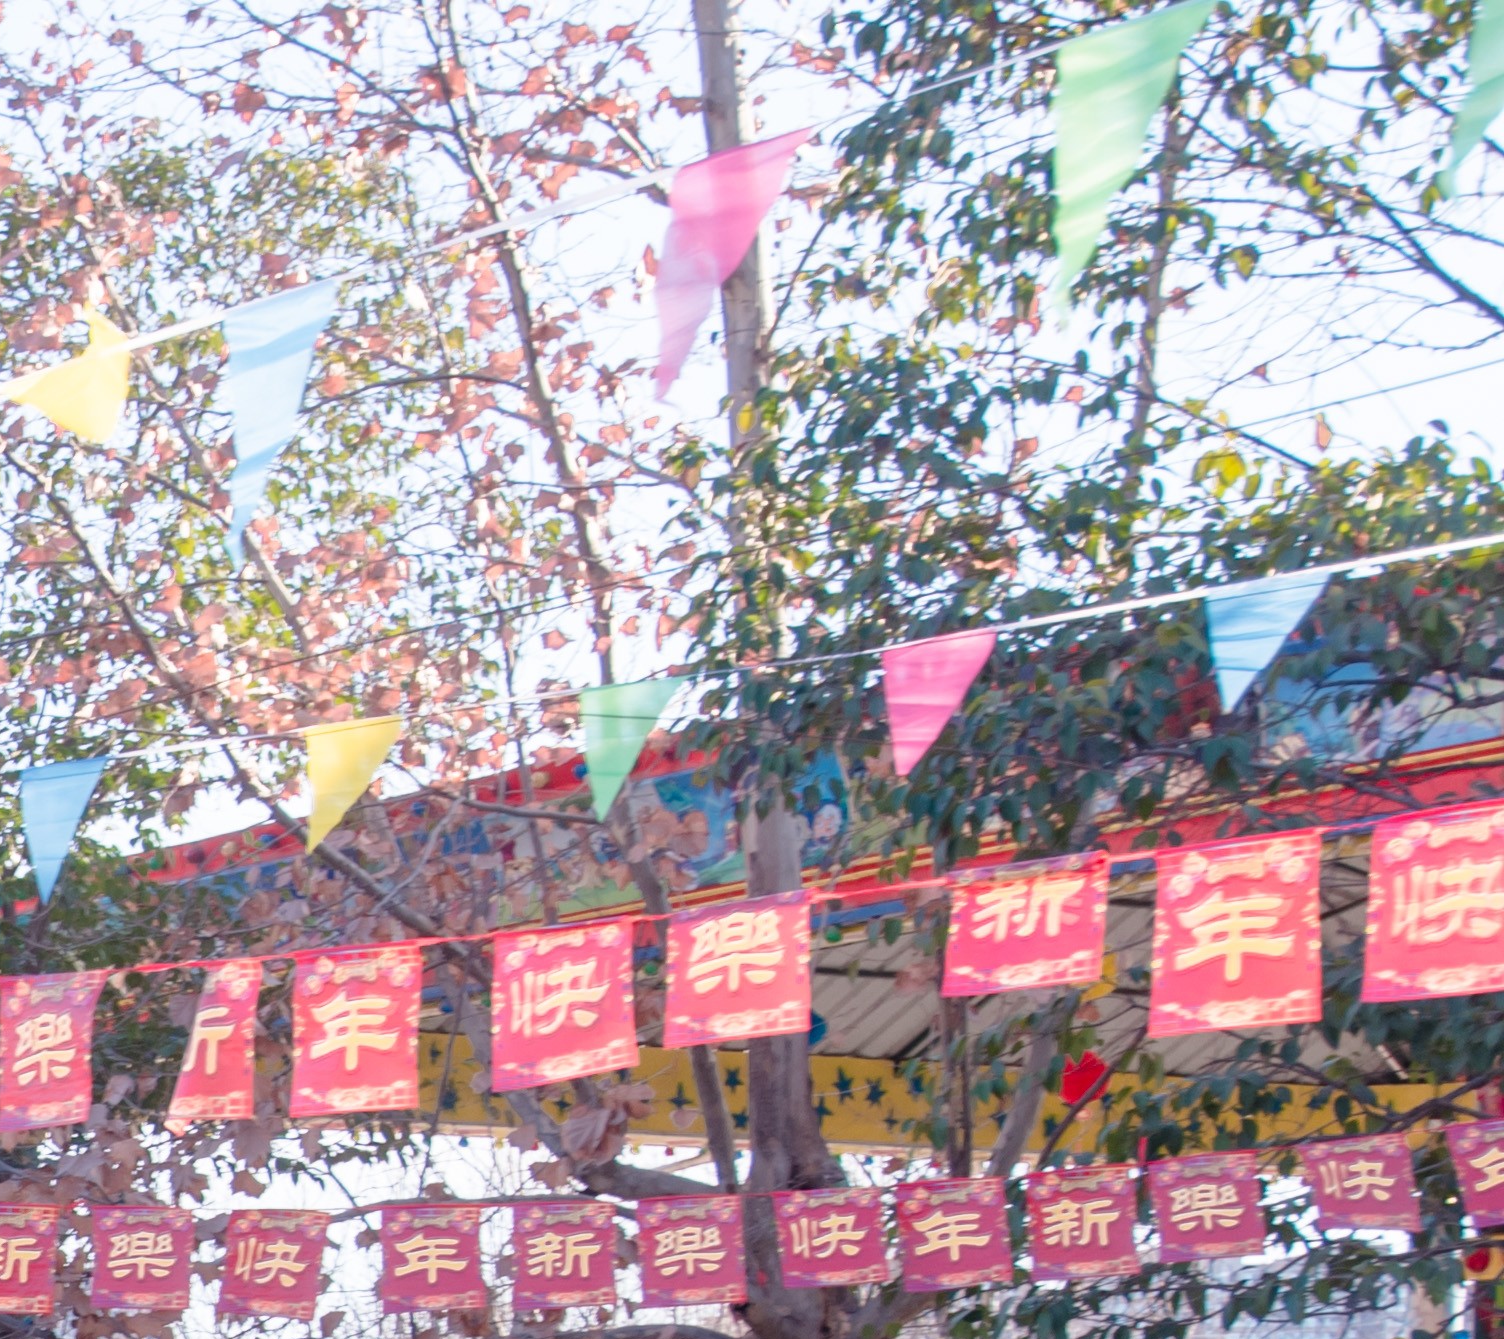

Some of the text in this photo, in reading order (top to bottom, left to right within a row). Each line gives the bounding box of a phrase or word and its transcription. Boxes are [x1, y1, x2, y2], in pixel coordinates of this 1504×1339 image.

[972, 876, 1086, 943] 新
[688, 908, 785, 995] 樂
[1174, 890, 1296, 982] 年
[510, 955, 611, 1037] 快
[13, 1011, 76, 1086] 樂
[308, 990, 399, 1072] 年
[1317, 1157, 1395, 1203] 快
[1041, 1198, 1121, 1248] 新
[1168, 1182, 1245, 1233] 樂
[106, 1230, 177, 1281] 樂
[234, 1236, 308, 1289] 快
[393, 1232, 469, 1284] 年
[526, 1231, 602, 1280] 新
[653, 1224, 726, 1278] 樂
[790, 1213, 868, 1262] 快
[912, 1211, 990, 1262] 年
